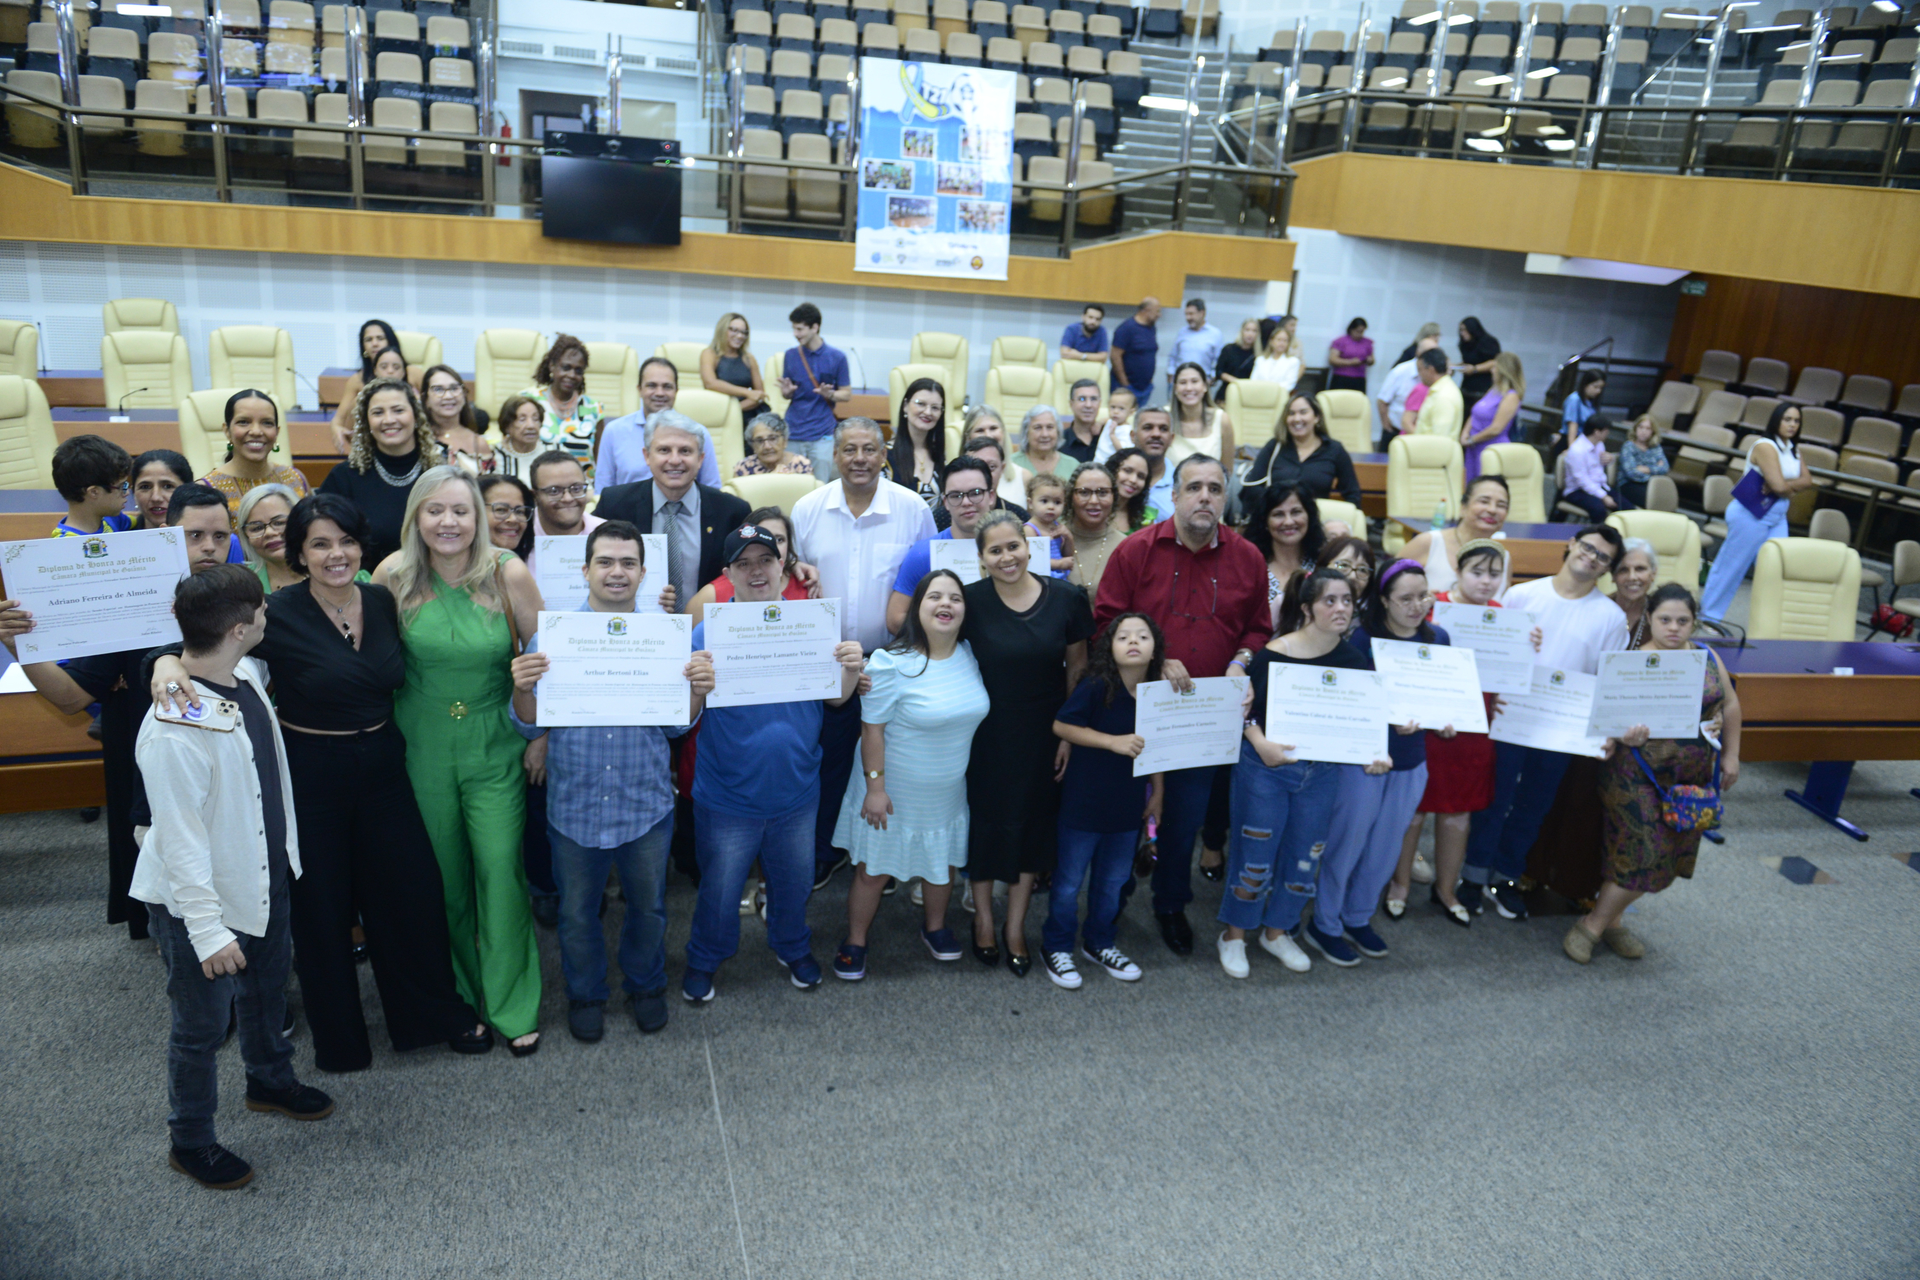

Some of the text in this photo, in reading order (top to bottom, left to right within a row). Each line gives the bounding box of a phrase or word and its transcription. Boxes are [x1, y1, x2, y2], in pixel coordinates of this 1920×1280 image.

[922, 82, 947, 104] T21
[38, 565, 74, 573] Diploma
[88, 560, 114, 568] Honra
[129, 556, 156, 565] Mérito
[51, 572, 78, 580] Câmara
[79, 568, 111, 578] Municipal
[122, 565, 146, 573] Goiânia
[48, 597, 80, 606] Adriano
[82, 593, 113, 602] Ferreira
[126, 588, 157, 597] Almeida
[568, 637, 597, 646] Diploma
[642, 638, 665, 646] Mérito
